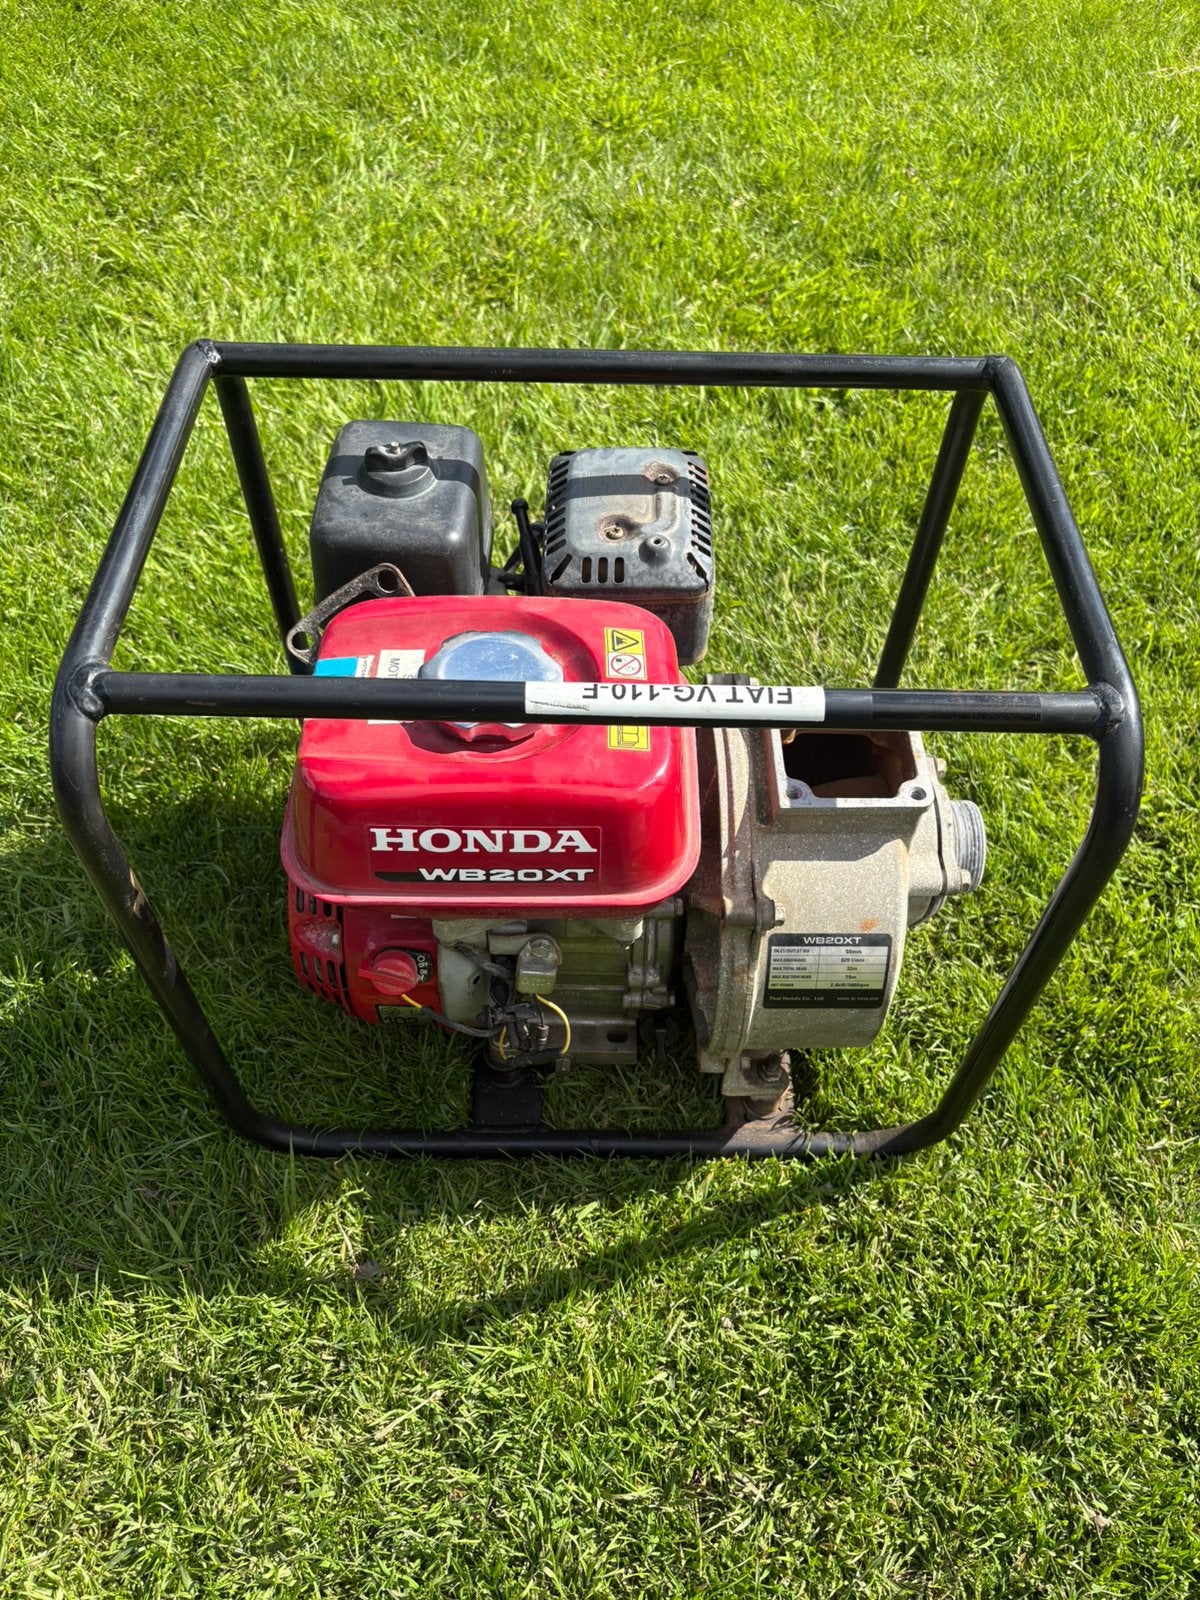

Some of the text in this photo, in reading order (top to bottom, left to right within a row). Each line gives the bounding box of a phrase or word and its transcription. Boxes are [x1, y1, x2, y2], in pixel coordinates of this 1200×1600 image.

[725, 686, 793, 705] FIAT
[370, 828, 597, 853] HONDA
[418, 868, 594, 881] WB20XT
[803, 936, 862, 945] WB20XT
